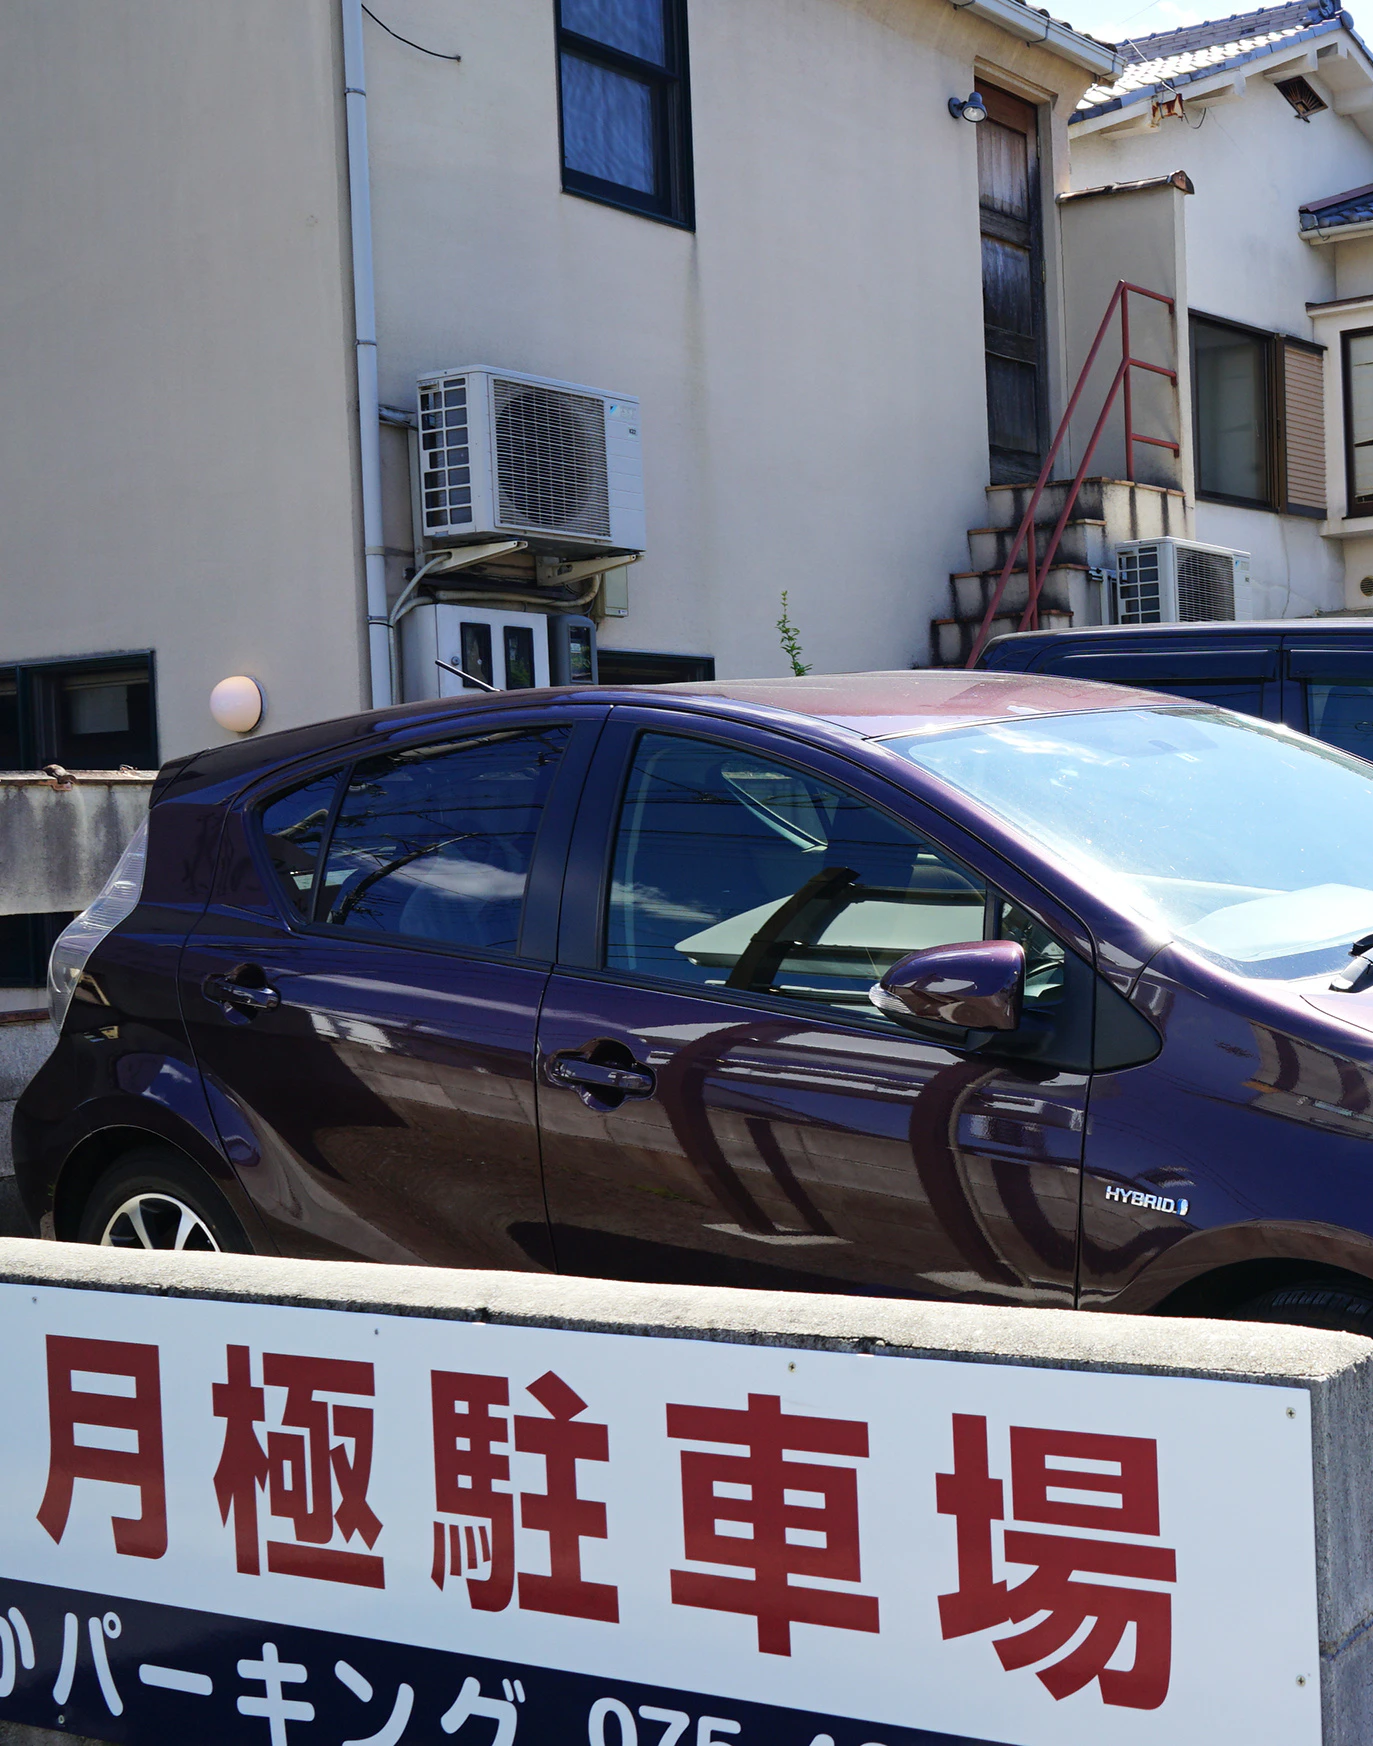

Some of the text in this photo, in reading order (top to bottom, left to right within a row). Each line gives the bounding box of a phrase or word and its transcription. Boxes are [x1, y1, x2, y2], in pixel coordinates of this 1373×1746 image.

[1105, 1185, 1176, 1214] HYBRID
[36, 1334, 1177, 1711] 月極駐車場
